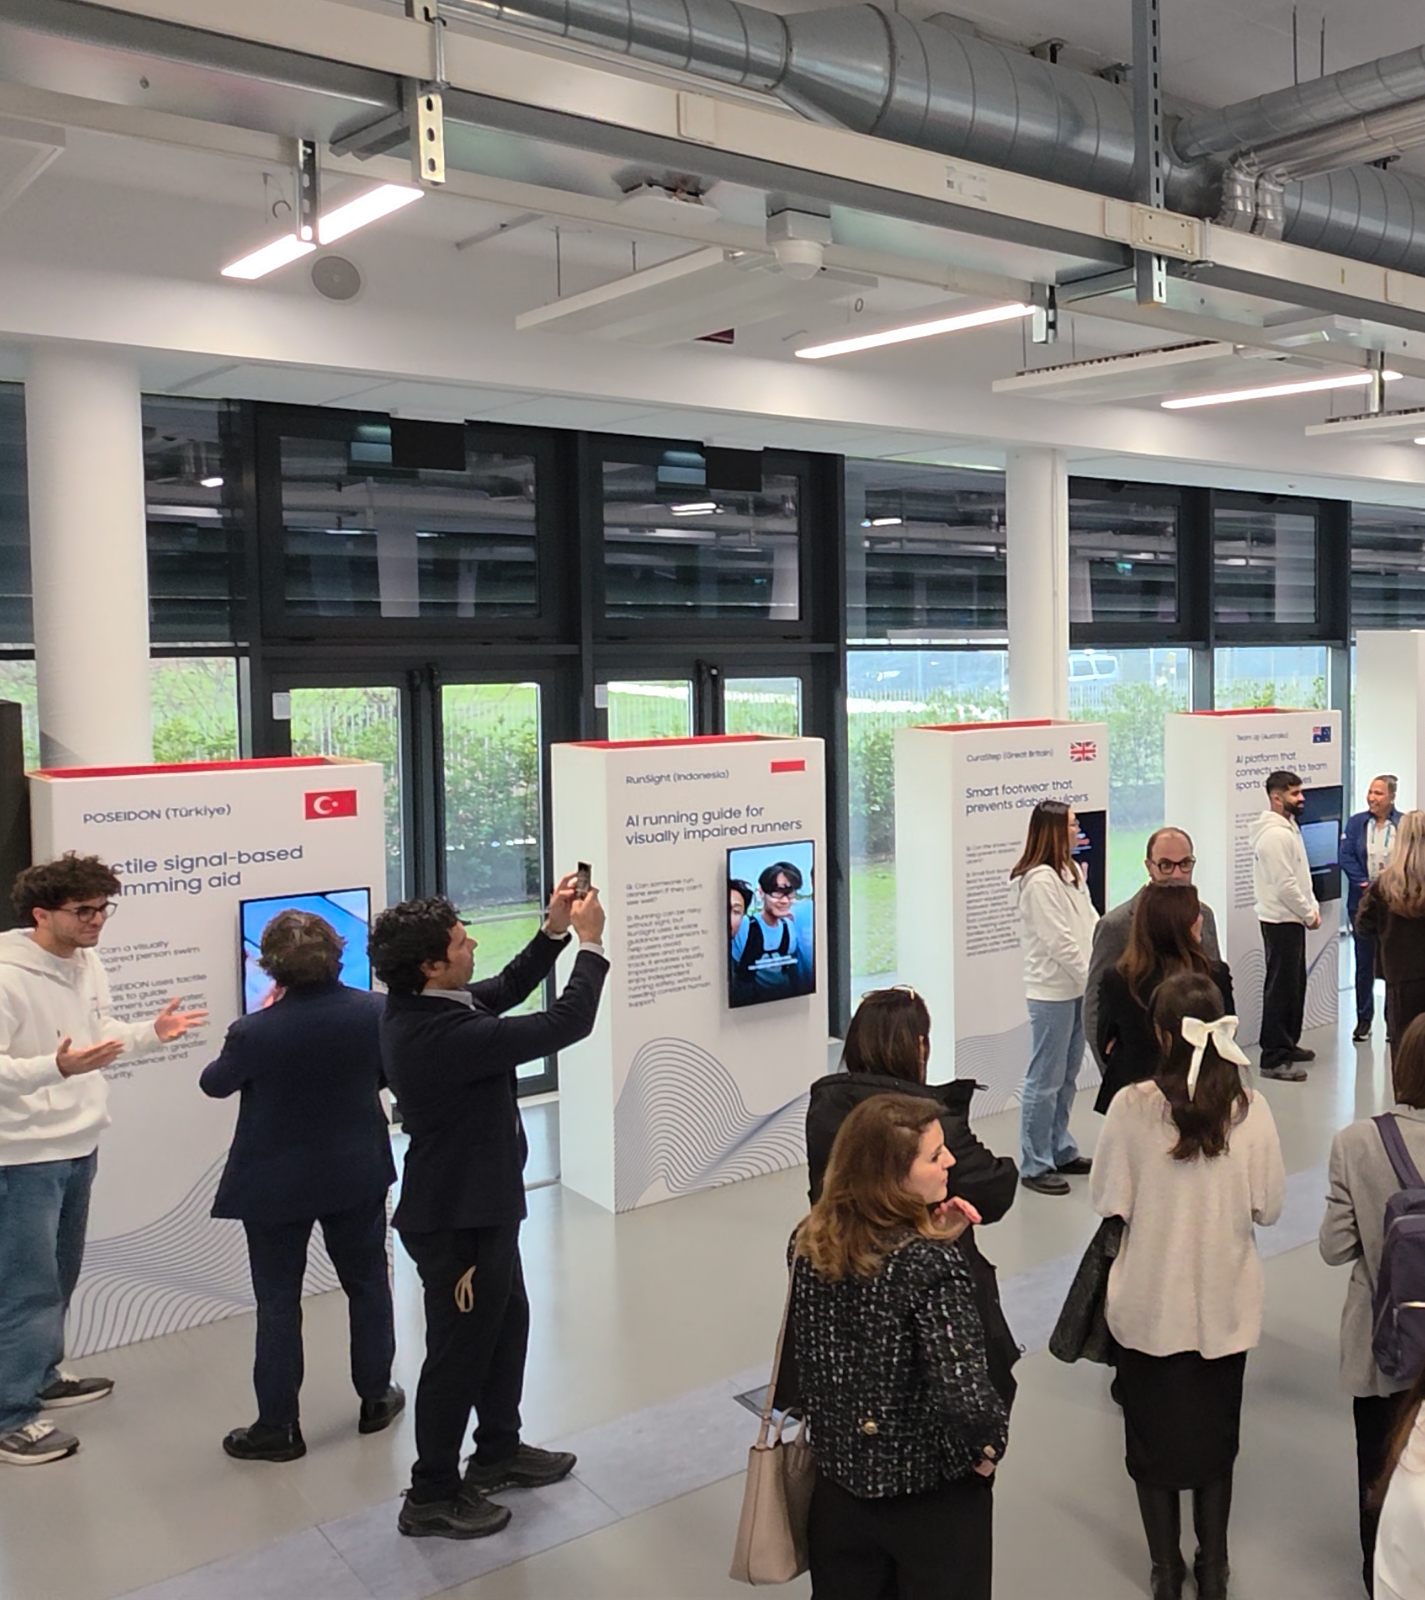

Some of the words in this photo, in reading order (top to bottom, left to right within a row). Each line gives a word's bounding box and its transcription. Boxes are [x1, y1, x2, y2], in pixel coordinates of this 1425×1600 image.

[1244, 752, 1279, 766] platform
[1280, 752, 1296, 761] that
[626, 773, 671, 786] RunSight
[673, 769, 730, 782] (Indonesia)
[1236, 766, 1271, 778] connects
[1298, 764, 1307, 772] to
[1308, 762, 1328, 772] team
[966, 786, 998, 799] Smart
[1002, 782, 1050, 794] footwear
[1052, 780, 1073, 791] that
[1236, 780, 1260, 792] sports
[83, 809, 161, 824] POSEIDON
[165, 803, 232, 820] (Türkiye)
[626, 814, 640, 828] AI
[642, 810, 698, 826] running
[702, 807, 742, 825] guide
[746, 804, 764, 818] for
[966, 799, 1014, 817] prevents
[626, 830, 680, 845] visually
[684, 823, 748, 842] impaired
[751, 819, 802, 834] runners
[110, 858, 158, 875] ctile
[164, 846, 304, 874] signal-based
[208, 870, 242, 888] aid
[100, 946, 121, 955] Can
[133, 940, 169, 950] visually
[136, 950, 172, 962] person
[168, 1051, 188, 1061] and
